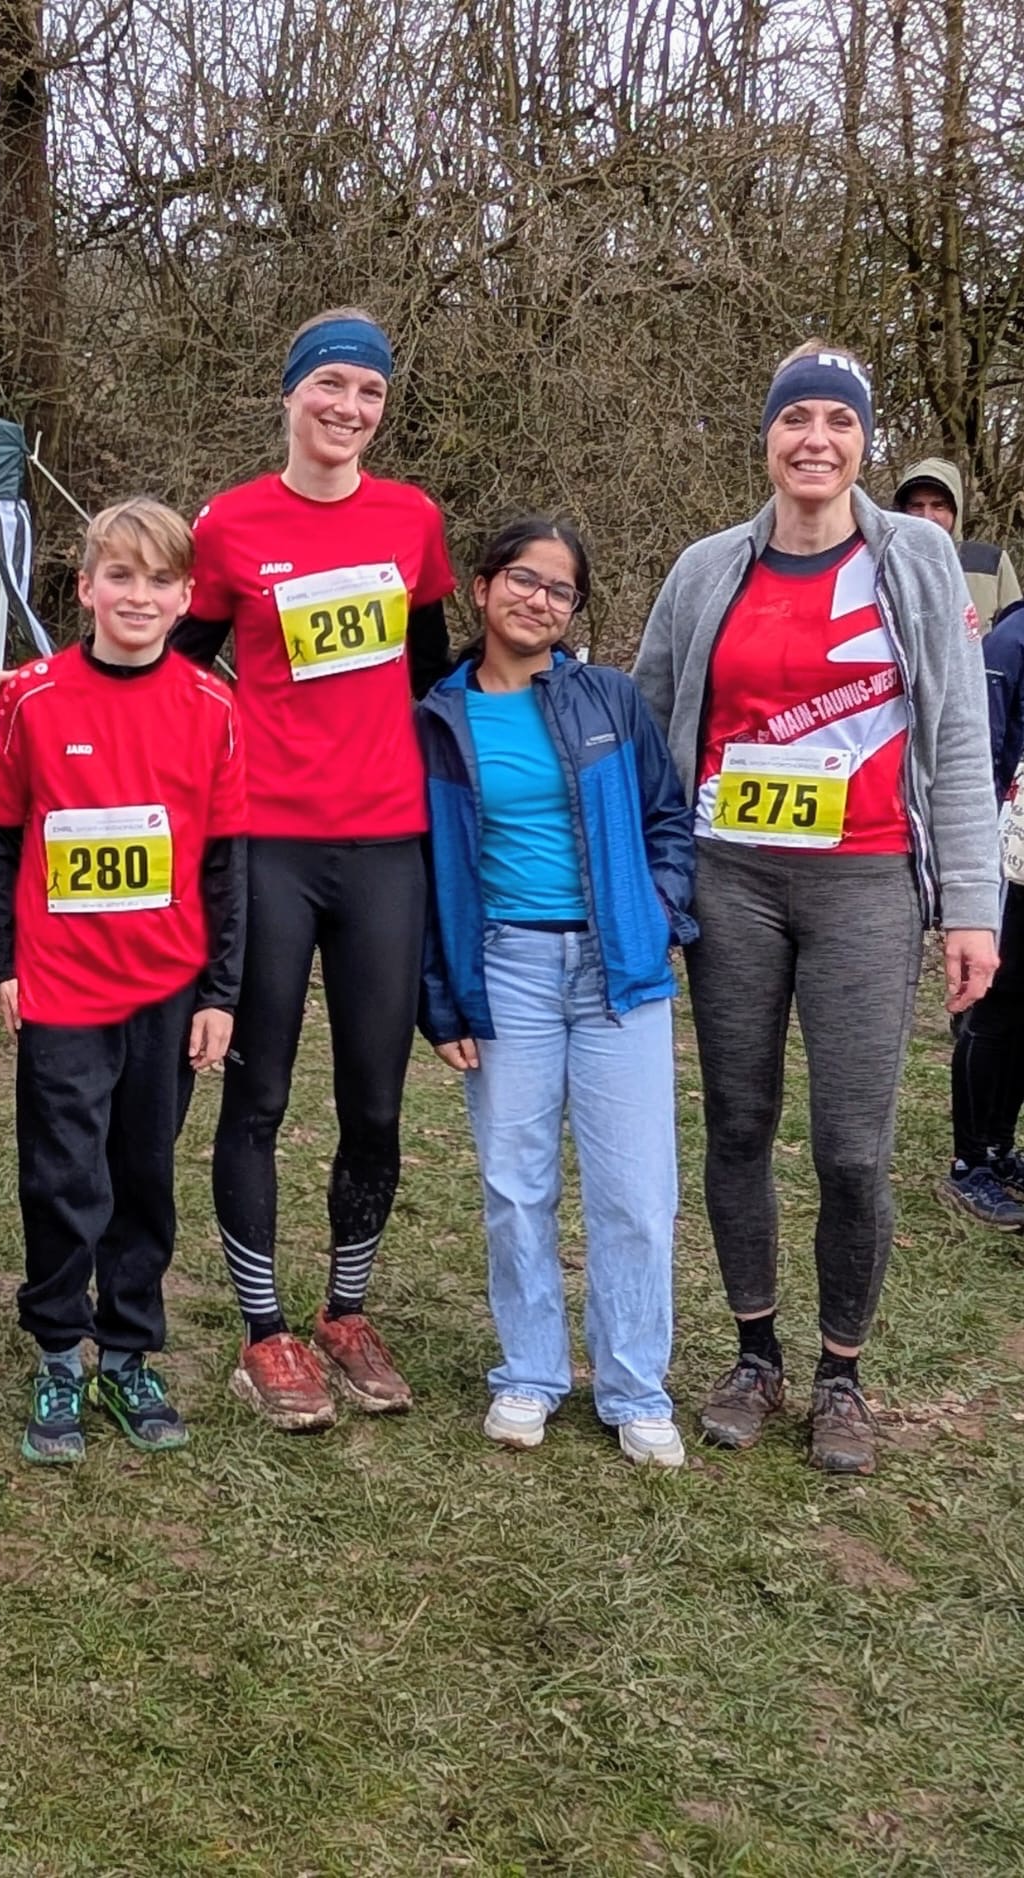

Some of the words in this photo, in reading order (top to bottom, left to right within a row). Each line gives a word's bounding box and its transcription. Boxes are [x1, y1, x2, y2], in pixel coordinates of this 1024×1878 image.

[259, 561, 294, 576] JAKO
[310, 599, 387, 655] 281
[66, 744, 93, 755] JAKO
[737, 781, 818, 828] 275
[69, 845, 149, 891] 280
